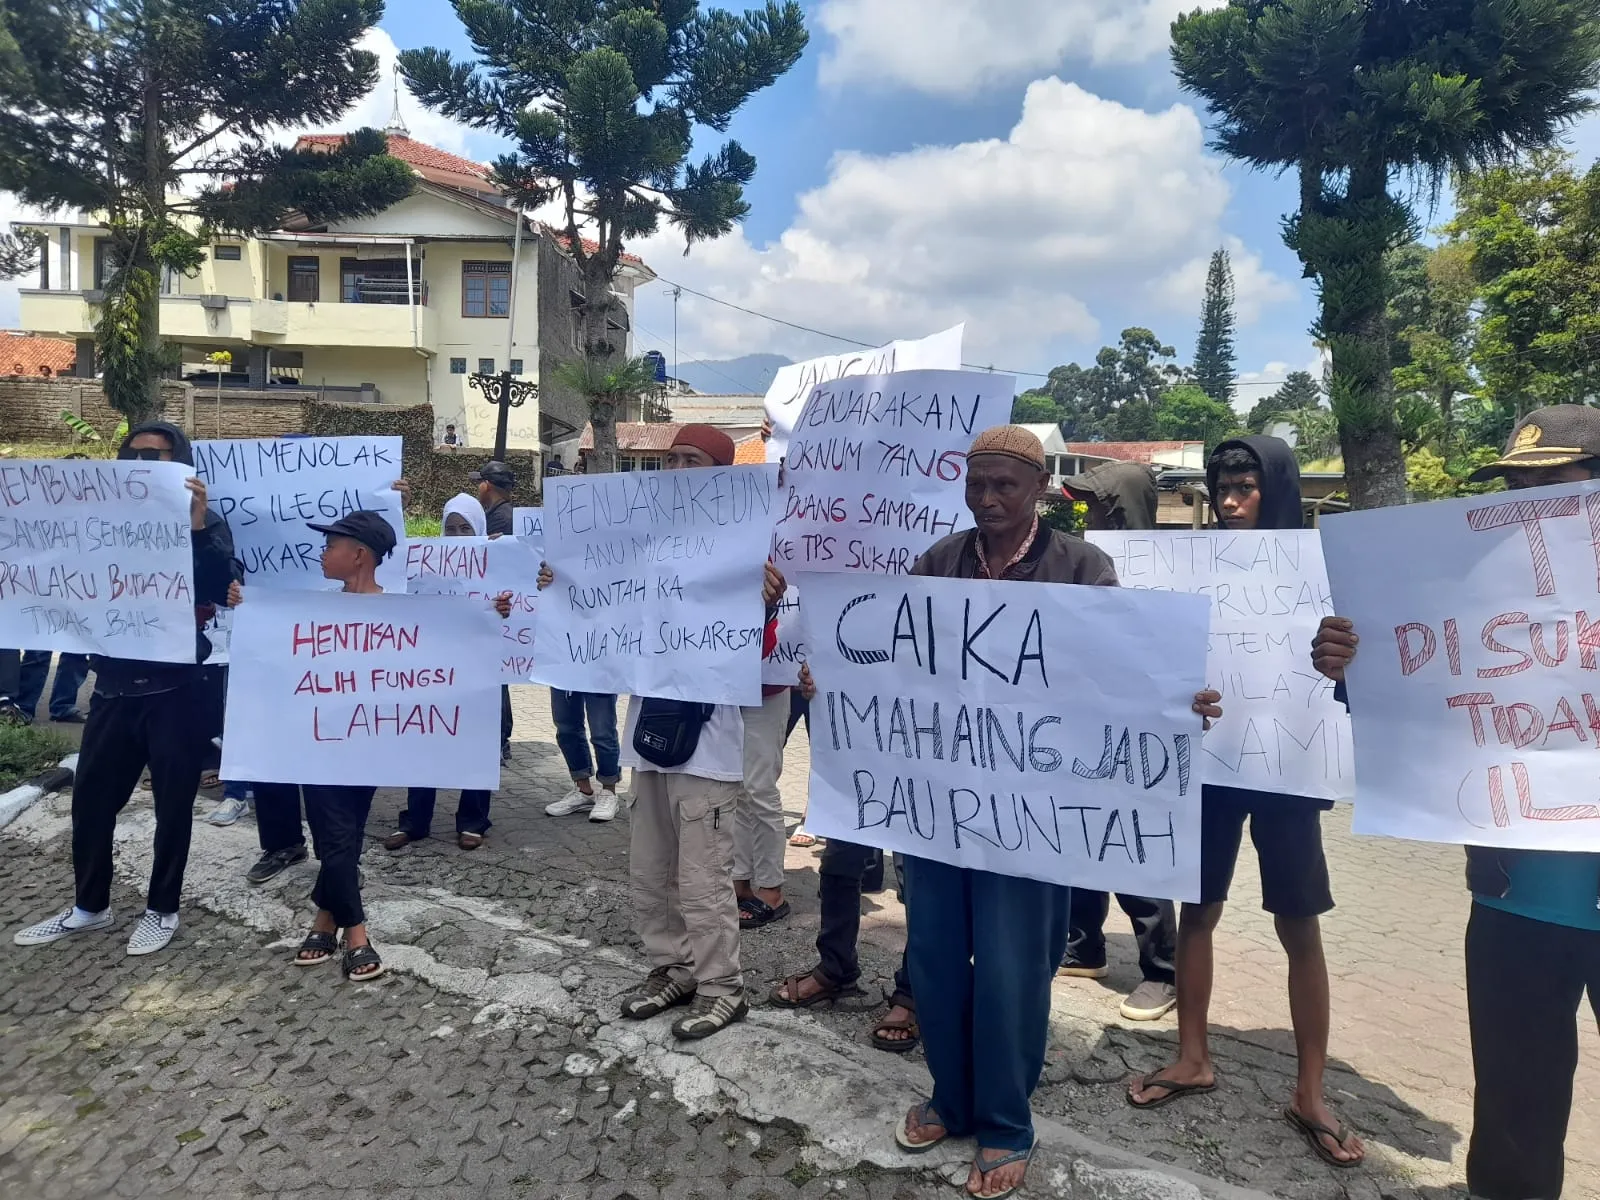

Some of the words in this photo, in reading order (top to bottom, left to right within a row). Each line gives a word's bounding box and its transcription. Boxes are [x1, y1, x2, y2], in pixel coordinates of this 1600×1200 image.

[798, 390, 981, 435] PENJARAKAN
[195, 443, 248, 485] AMI
[257, 440, 393, 478] MENOLAK
[788, 436, 864, 472] OKNUM
[877, 439, 968, 482] YANG
[0, 464, 152, 508] EMBUANG
[270, 486, 390, 526] ILEGAL
[555, 471, 772, 541] PENJARAKEUN
[775, 485, 848, 526] BUANG
[858, 492, 959, 535] SAMPAH
[0, 516, 81, 554] SAMPAH
[85, 516, 191, 552] SEMBARANG
[583, 542, 626, 572] ANU
[631, 532, 715, 567] MICEUN
[772, 532, 796, 563] KE
[801, 534, 837, 563] TPS
[844, 539, 920, 577] SUKAR
[1466, 490, 1600, 598] T
[241, 542, 328, 575] UKAR
[406, 543, 488, 580] ERIKAN
[0, 560, 99, 602] PRILAKU
[107, 563, 192, 605] BUDAYA
[567, 578, 647, 612] RUNTAH
[656, 574, 684, 603] KA
[20, 605, 93, 636] TIDAK
[103, 608, 167, 638] BAIK
[292, 620, 420, 659] HENTIKAN
[836, 592, 938, 676] CAI
[961, 597, 1049, 689] KA
[565, 623, 644, 666] WILAYAH
[768, 641, 807, 665] ANG
[1394, 617, 1462, 676] DI
[293, 669, 357, 696] ALIH
[371, 666, 455, 693] FUNGSI
[313, 702, 460, 742] LAHAN
[1071, 724, 1192, 797] JADI
[852, 769, 935, 841] BAU
[948, 787, 1177, 867] RUNTAH
